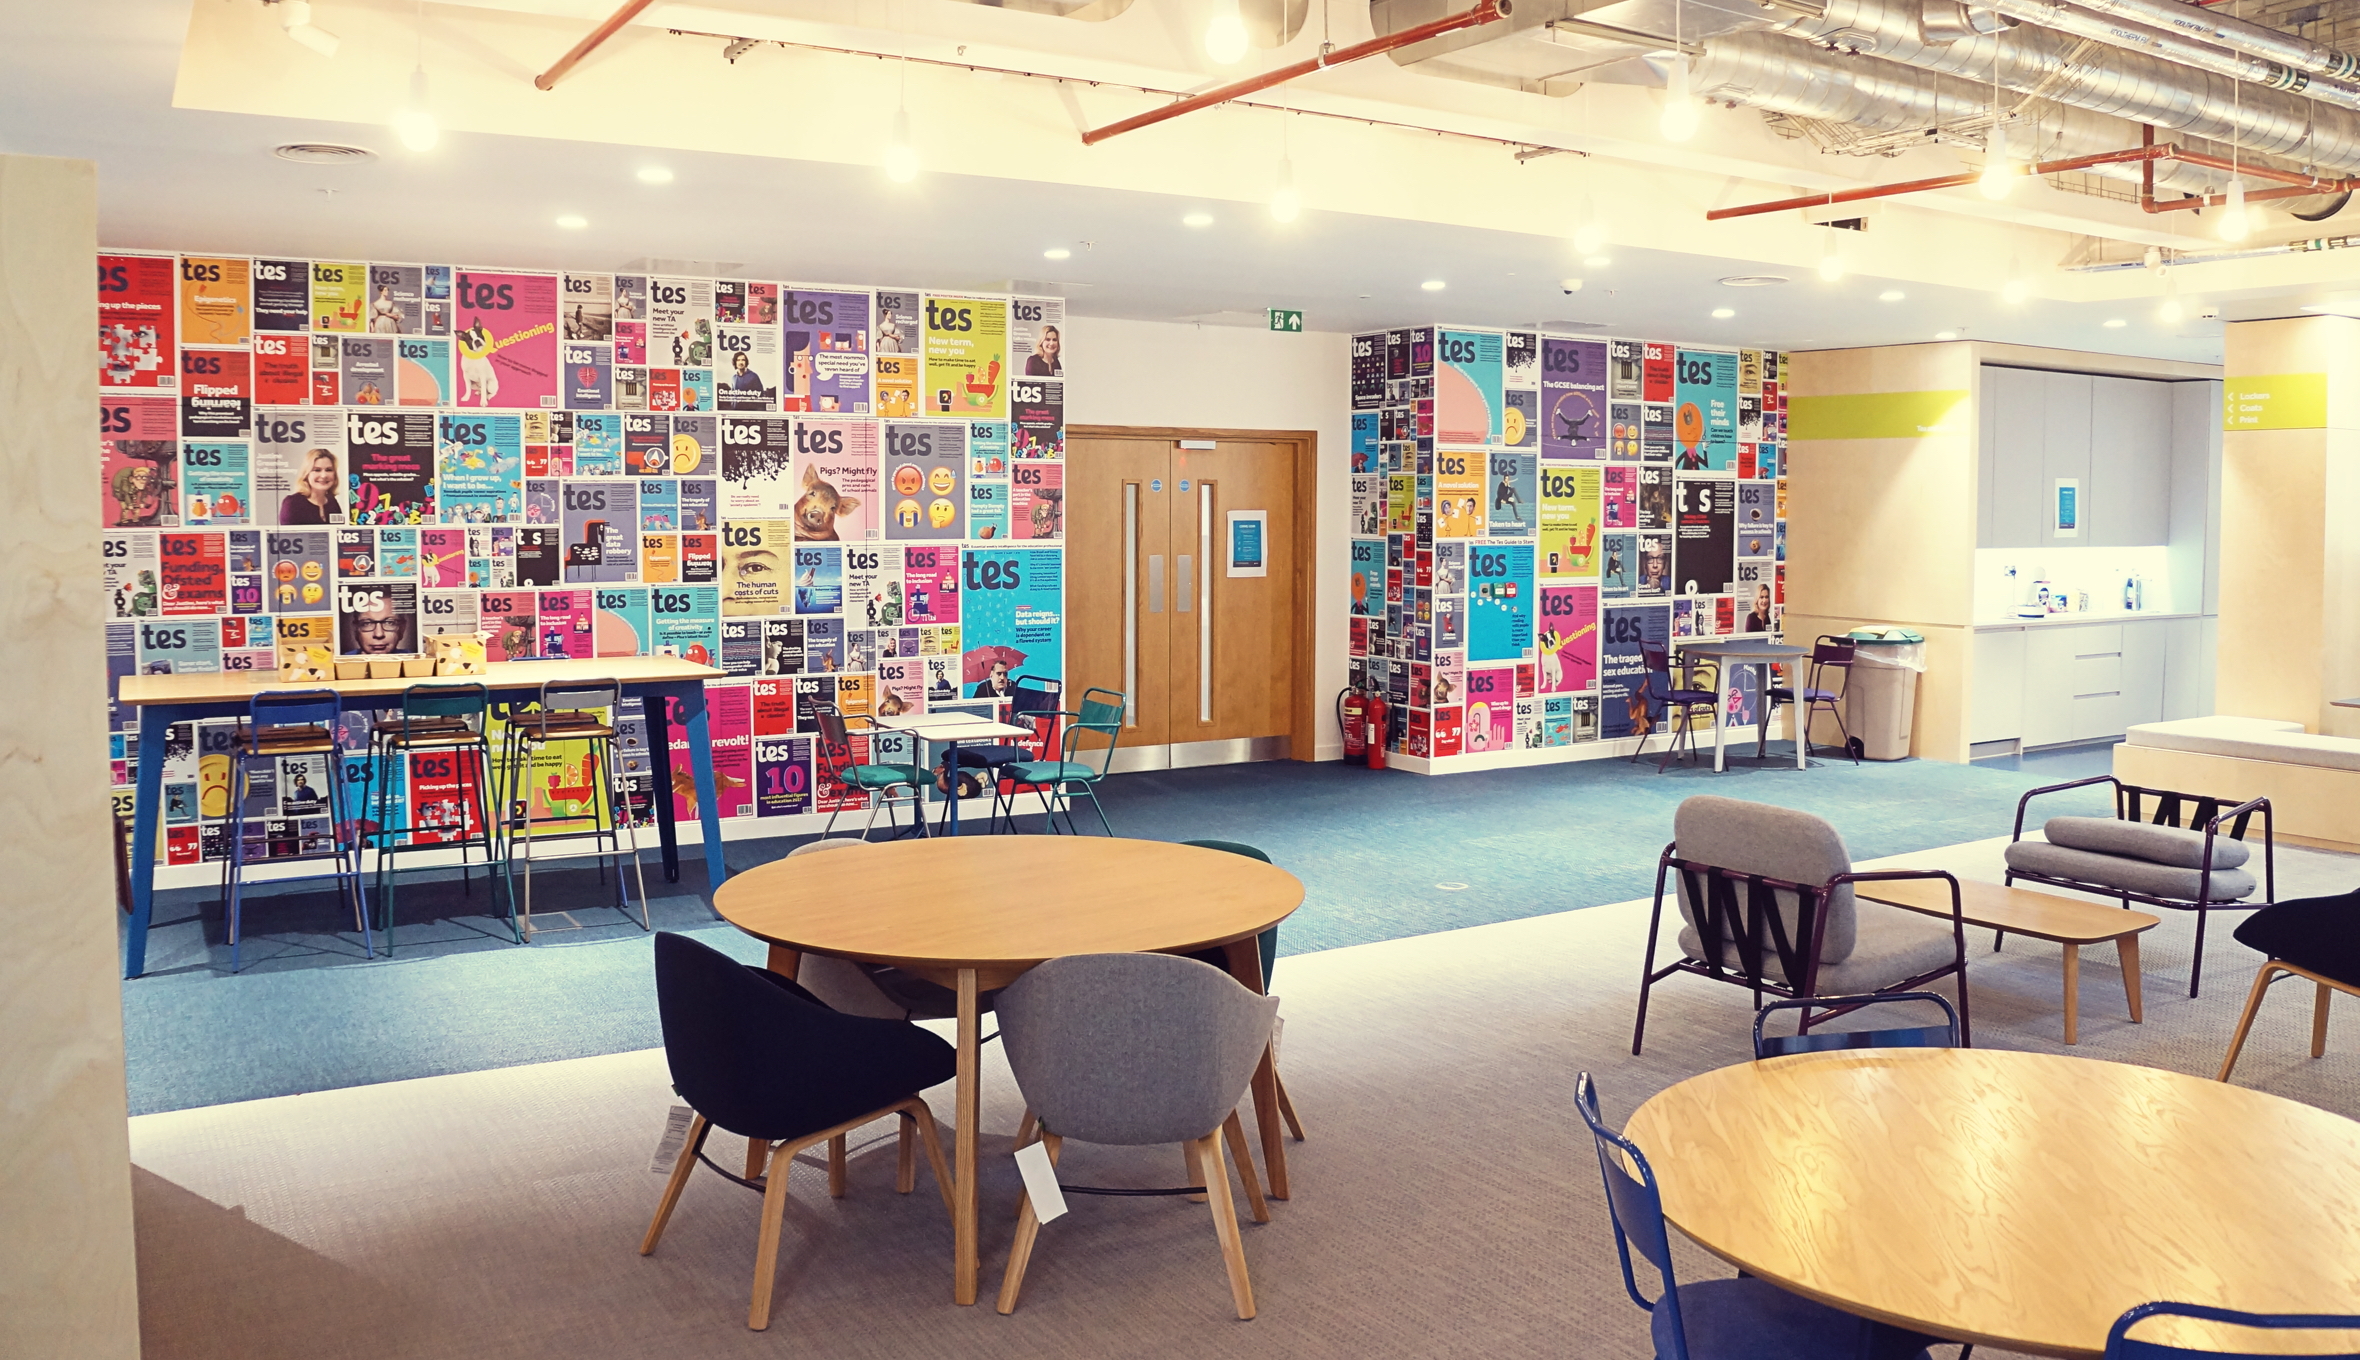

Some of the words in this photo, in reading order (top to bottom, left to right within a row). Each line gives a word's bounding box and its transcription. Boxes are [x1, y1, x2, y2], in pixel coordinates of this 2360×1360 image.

[181, 259, 220, 282] tes
[254, 261, 286, 280] tes
[313, 264, 343, 282] tes
[370, 266, 399, 285] tes
[457, 274, 514, 310] tes
[564, 276, 592, 293] tes
[651, 281, 686, 304] tes
[137, 302, 161, 310] pieces
[784, 292, 833, 325] tes
[876, 292, 901, 309] tes
[926, 300, 972, 331] tes
[1013, 301, 1041, 321] tes
[254, 336, 286, 354] tes
[399, 340, 428, 358] tes
[718, 330, 751, 351] tes
[950, 338, 974, 348] term,
[1439, 333, 1475, 363] tes
[565, 349, 592, 364] tes
[949, 348, 965, 356] you
[182, 350, 220, 374] tes
[877, 358, 900, 373] tes
[1676, 353, 1711, 385] tes
[194, 384, 238, 396] Flipped
[746, 389, 761, 397] duty
[1554, 381, 1570, 389] GCSE
[1570, 382, 1595, 391] balancing
[1711, 400, 1724, 408] Free
[255, 414, 306, 443] tes
[348, 415, 398, 445] tes
[440, 418, 487, 445] tes
[1711, 418, 1729, 426] minds
[722, 419, 761, 445] tes
[794, 423, 843, 454] tes
[886, 425, 932, 456] tes
[183, 444, 221, 465] tes
[1437, 453, 1465, 475] tes
[820, 467, 840, 476] Pigs?
[842, 467, 864, 476] Might
[866, 467, 877, 476] fly
[1541, 470, 1575, 498] tes
[564, 485, 606, 510] tes
[1556, 513, 1570, 521] you
[605, 534, 623, 542] great
[722, 523, 761, 547] tes
[161, 535, 197, 555] tes
[605, 548, 630, 556] robbery
[162, 562, 224, 575] Funding,
[963, 552, 1020, 590] tes
[1469, 547, 1506, 577] tes
[162, 575, 212, 585] Ofsted
[178, 590, 224, 599] exams
[236, 588, 257, 602] 10
[338, 586, 384, 613] tes
[652, 590, 691, 613] tes
[141, 625, 187, 650] tes
[1603, 655, 1618, 664] The
[1619, 654, 1644, 664] traged
[1617, 665, 1653, 675] educatin
[712, 735, 749, 748] revolt!
[756, 743, 788, 762] tes
[410, 755, 450, 778] tes
[765, 765, 805, 794] 10
